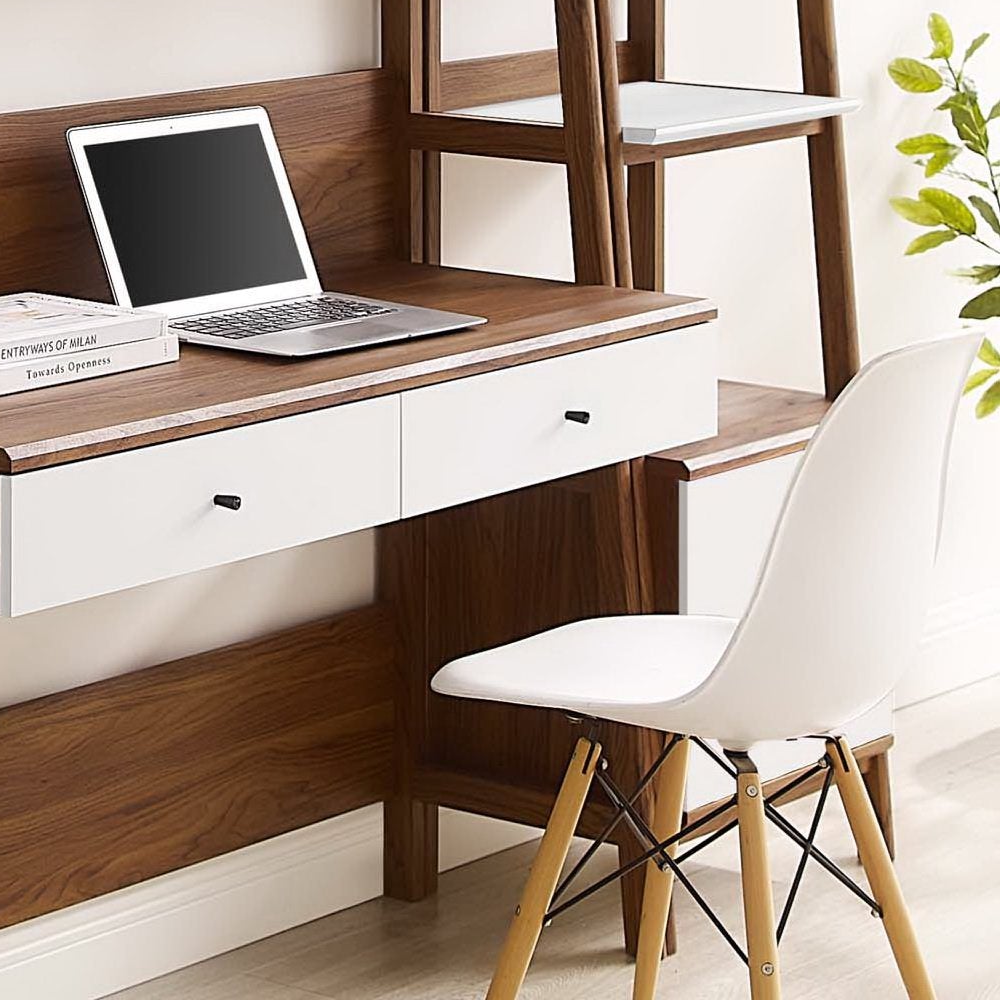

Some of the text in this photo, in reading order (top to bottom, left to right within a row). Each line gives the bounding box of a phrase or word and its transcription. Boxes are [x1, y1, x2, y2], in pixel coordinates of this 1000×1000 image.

[1, 334, 97, 360] ENTRYWAYS OF MILAN
[26, 356, 111, 380] Towards Openness
